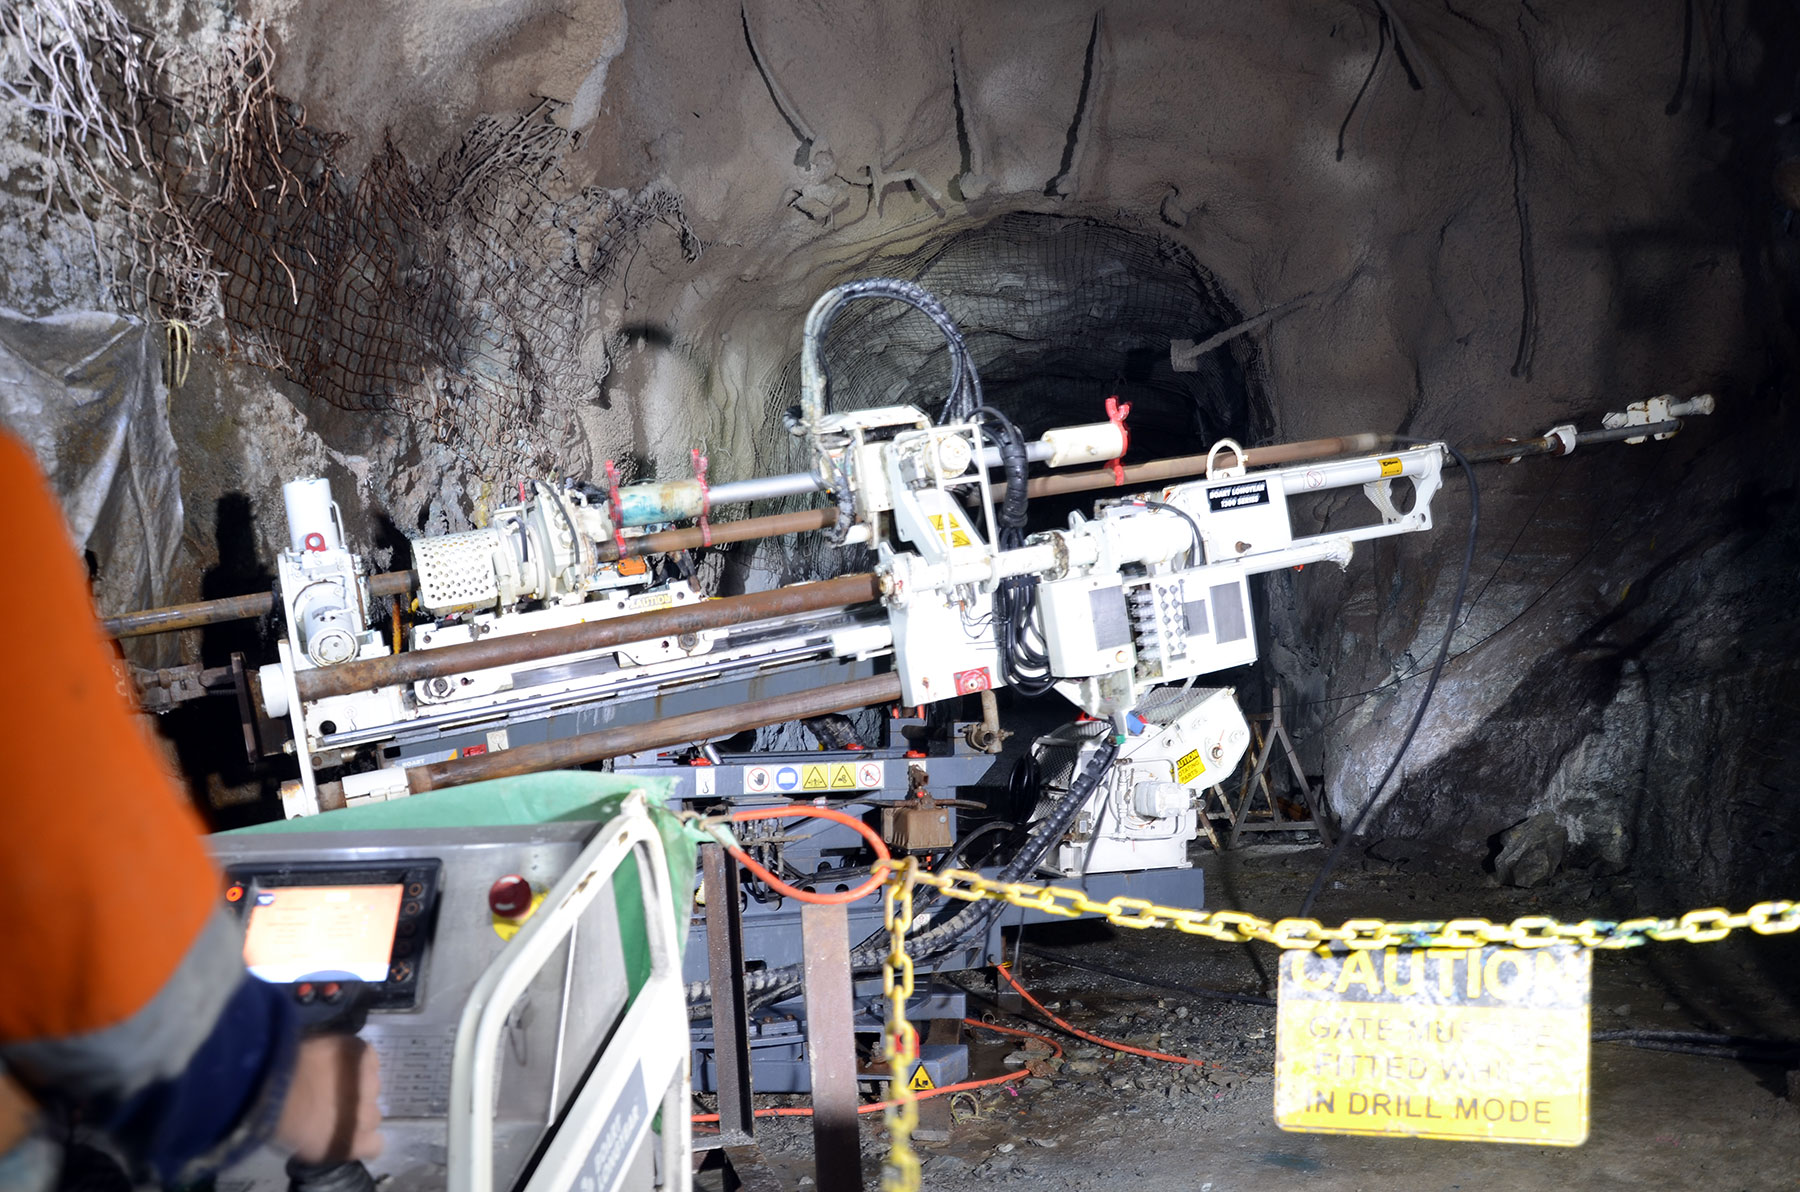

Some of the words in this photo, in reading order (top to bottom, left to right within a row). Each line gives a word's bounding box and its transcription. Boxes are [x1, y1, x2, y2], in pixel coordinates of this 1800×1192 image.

[1178, 760, 1200, 776] OTATING
[1309, 1016, 1393, 1042] GATE
[1316, 1053, 1428, 1080] FITTED
[1304, 1089, 1335, 1114] IN
[1348, 1092, 1442, 1119] DRILL
[1455, 1097, 1552, 1125] MODE
